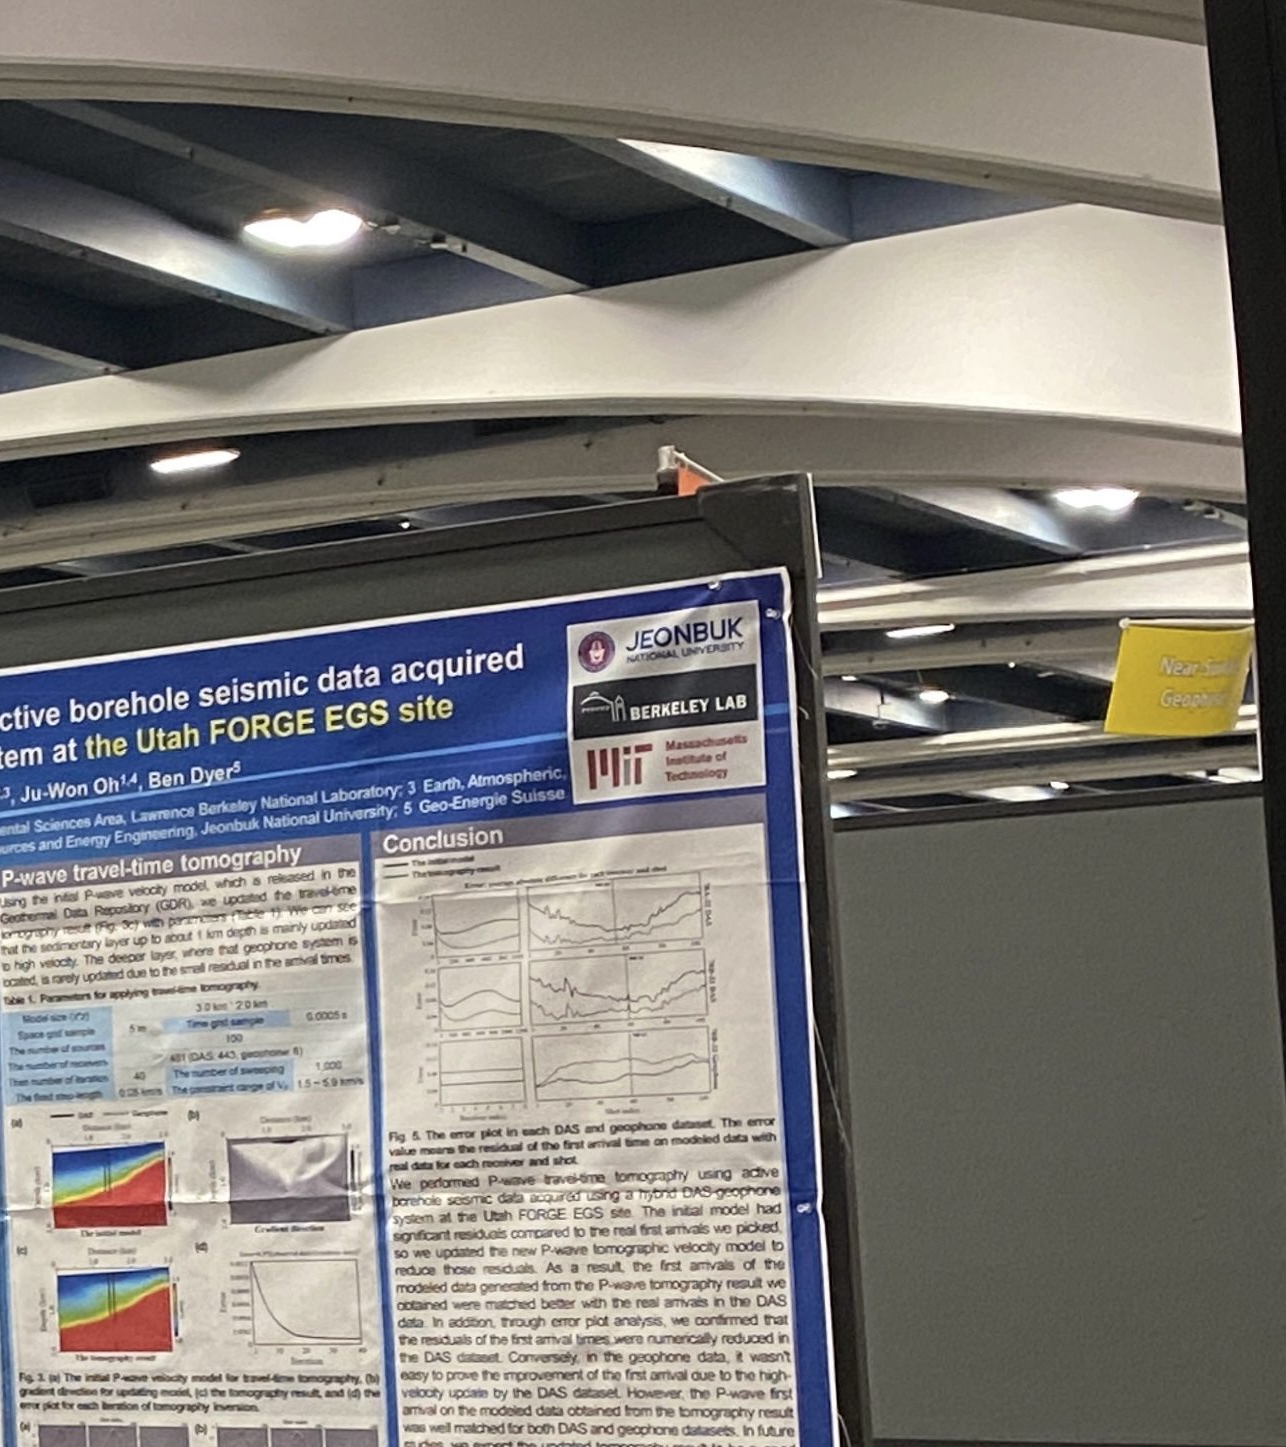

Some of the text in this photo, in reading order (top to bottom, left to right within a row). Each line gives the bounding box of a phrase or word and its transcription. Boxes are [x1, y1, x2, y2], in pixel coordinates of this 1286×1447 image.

[625, 617, 743, 651] JEONBUK
[626, 641, 744, 663] NATIONAL UNIVERSITY
[69, 687, 189, 722] borehole
[198, 672, 309, 707] seismic
[316, 663, 380, 693] data
[390, 643, 524, 686] acquired
[630, 695, 747, 720] BERKELEY LAB
[52, 736, 78, 762] at
[85, 732, 128, 758] the
[136, 722, 199, 752] Utah
[209, 708, 315, 744] FORGE
[325, 700, 389, 731] EGS
[398, 694, 453, 723] site
[665, 733, 747, 751] Massachusetts
[587, 743, 654, 789] MIT
[666, 751, 726, 766] Institute of
[19, 781, 88, 802] Ju-Won
[147, 771, 184, 788] Ben
[665, 766, 728, 784] Technology
[382, 827, 503, 854] Conclusion
[1, 843, 303, 888] P-wave travel-time tomography
[392, 1211, 435, 1225] system
[437, 1210, 452, 1221] at
[456, 1210, 478, 1221] the
[482, 1209, 513, 1220] Utah
[518, 1207, 566, 1219] FORGE
[573, 1206, 604, 1218] EGS
[641, 1205, 666, 1217] The
[671, 1204, 704, 1216] initial
[709, 1203, 749, 1215] model
[755, 1202, 782, 1214] had
